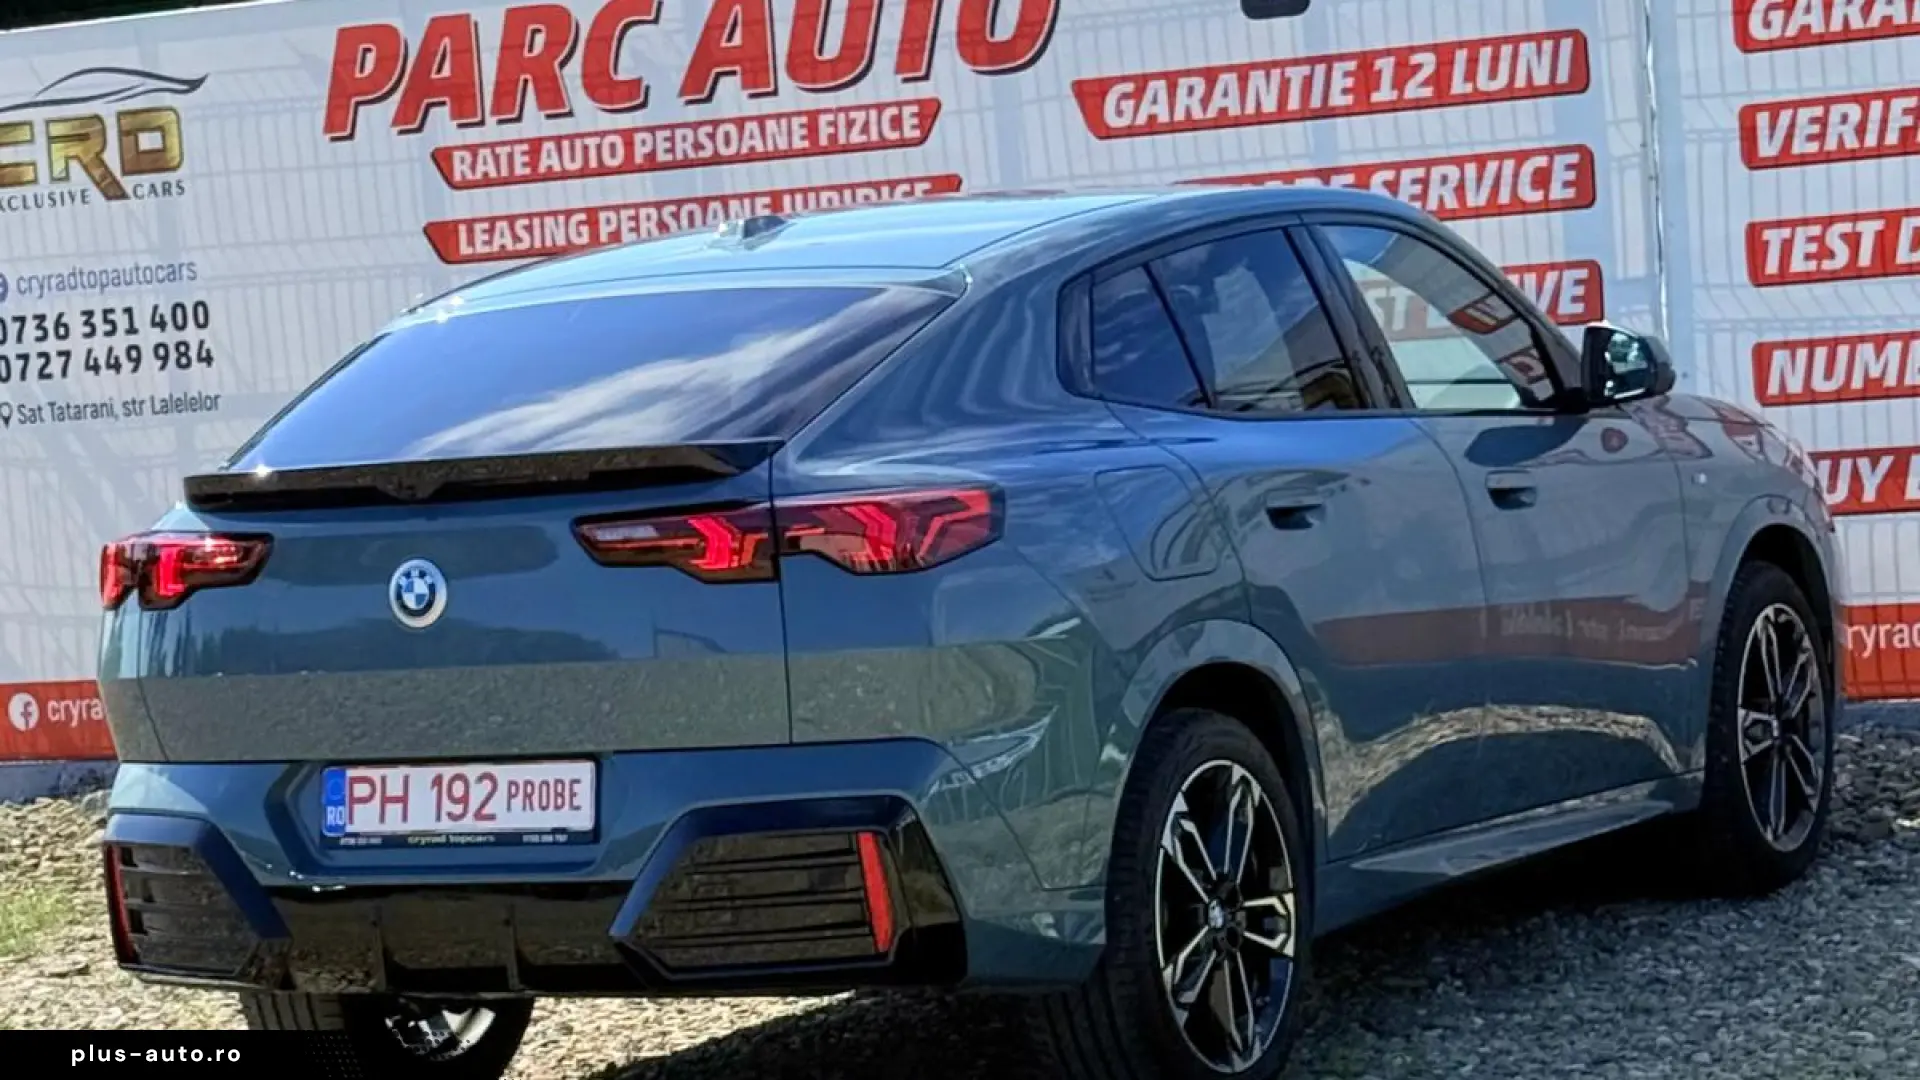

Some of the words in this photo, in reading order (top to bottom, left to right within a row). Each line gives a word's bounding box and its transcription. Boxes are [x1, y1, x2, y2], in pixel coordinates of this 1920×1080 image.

[1748, 0, 1920, 41] GARA
[323, 0, 664, 142] PARC
[1102, 53, 1359, 128] GARANTIE
[1369, 51, 1435, 102] 12
[1449, 36, 1574, 96] LUNI
[452, 143, 532, 182] RATE
[538, 133, 625, 174] AUTO
[633, 116, 809, 165] PERSOANE
[817, 105, 921, 147] FIZICE
[1755, 95, 1920, 158] VERIF
[132, 178, 186, 200] CARS
[1368, 152, 1582, 212] SERVICE
[456, 212, 590, 256] LEASING
[1761, 218, 1886, 277] TEST
[16, 261, 198, 299] cryradtopautocars
[80, 306, 140, 339] 351
[150, 299, 210, 333] 400
[0, 349, 72, 384] 0727
[84, 343, 143, 376] 449
[153, 338, 215, 371] 984
[16, 403, 45, 425] Sat
[48, 397, 119, 422] Tatarani,
[122, 398, 146, 417] str
[150, 389, 222, 415] Lalelelor
[325, 804, 345, 826] RO
[348, 774, 410, 825] PH
[430, 771, 499, 822] 192
[506, 778, 582, 812] PROBE
